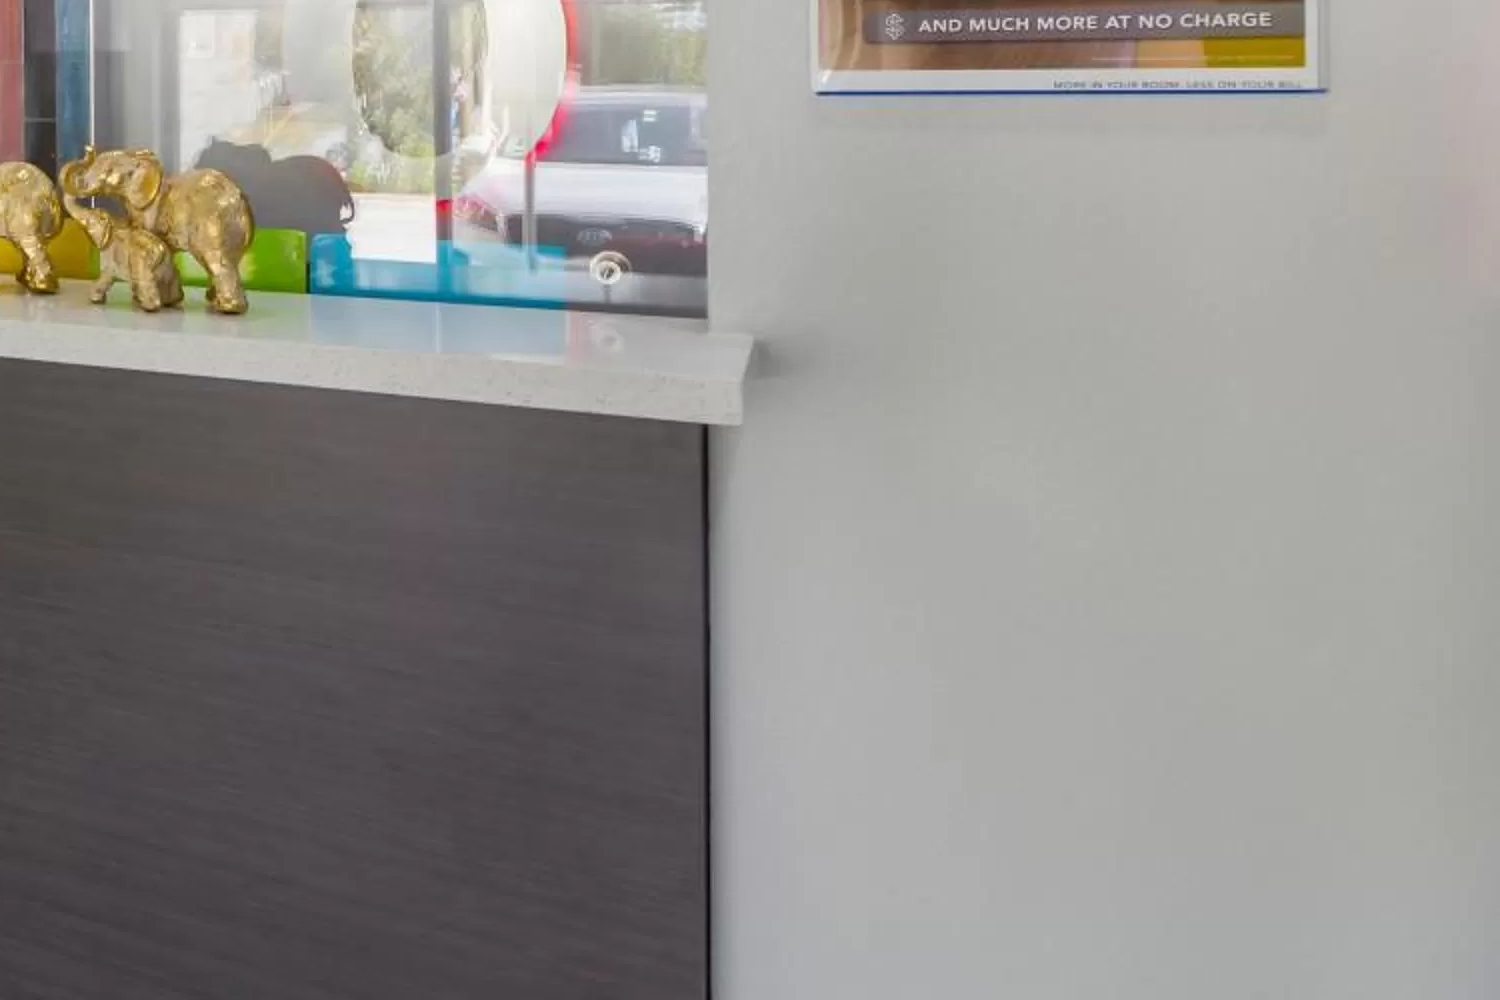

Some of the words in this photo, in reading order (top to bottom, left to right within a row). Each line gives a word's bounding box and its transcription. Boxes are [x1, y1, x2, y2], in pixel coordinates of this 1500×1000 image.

[918, 18, 962, 33] AND
[968, 16, 1029, 32] MUCH
[1036, 14, 1098, 31] MORE
[1104, 14, 1132, 30] AT
[1138, 13, 1173, 30] NO
[1179, 11, 1273, 28] CHARGE
